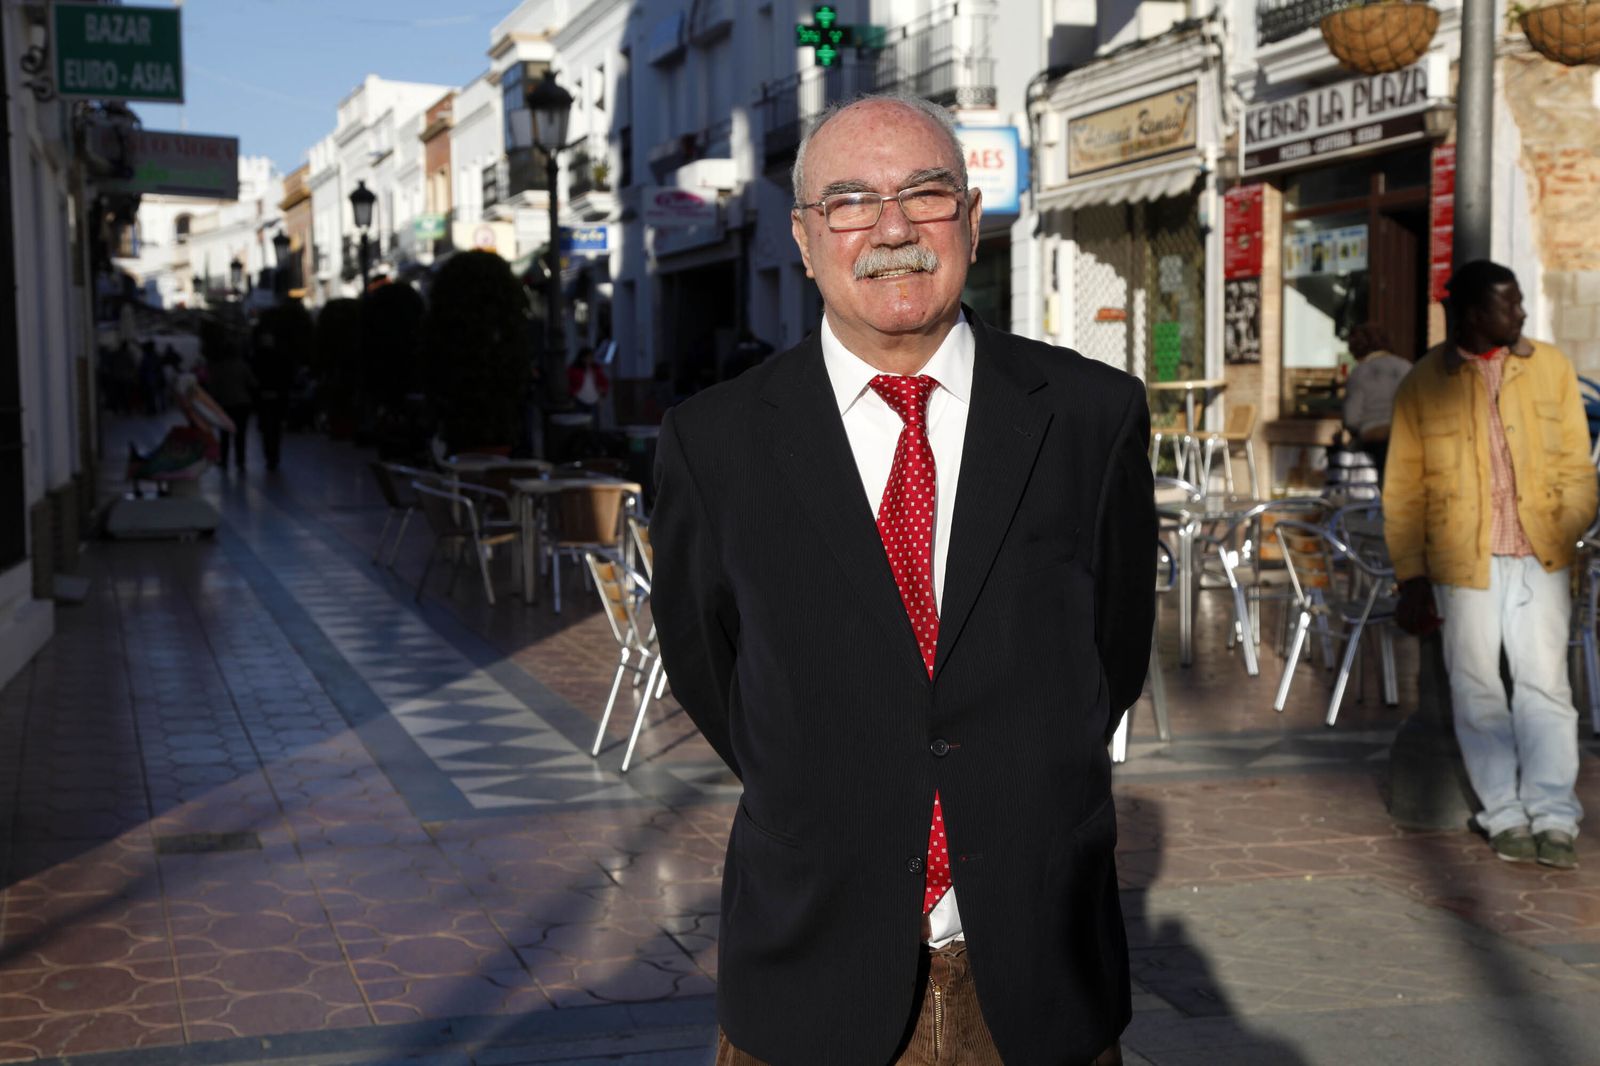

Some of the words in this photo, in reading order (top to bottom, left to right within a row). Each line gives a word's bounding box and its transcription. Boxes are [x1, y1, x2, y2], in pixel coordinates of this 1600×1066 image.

[85, 13, 151, 45] BAZAR
[1245, 97, 1309, 144] KEBAB
[1317, 88, 1344, 127] LA
[1352, 67, 1428, 119] PLAZA
